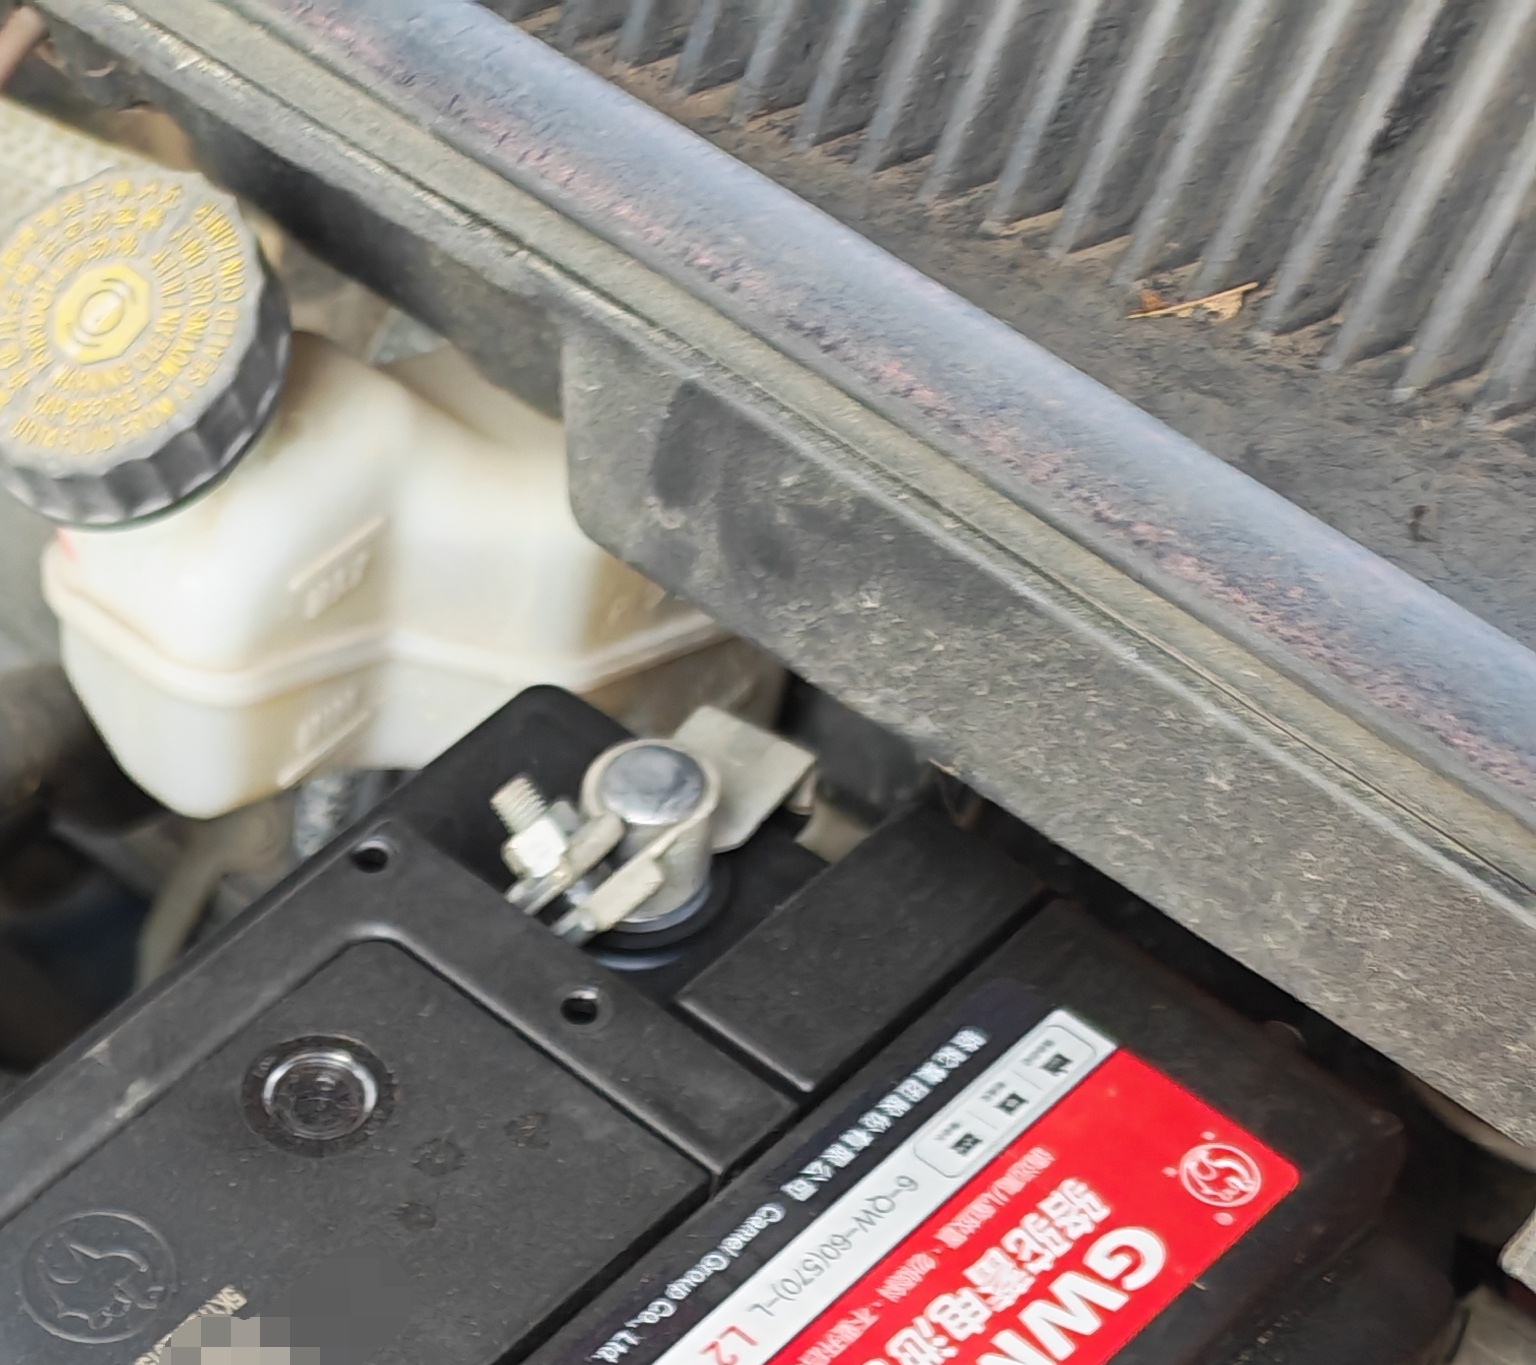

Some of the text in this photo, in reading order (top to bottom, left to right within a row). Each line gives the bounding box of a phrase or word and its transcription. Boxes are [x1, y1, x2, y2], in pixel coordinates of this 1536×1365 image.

[136, 313, 185, 373] CLEAN
[139, 308, 209, 400] REMOVING
[187, 306, 239, 387] SEALED
[717, 1201, 786, 1258] Camel
[663, 1249, 731, 1301] Group
